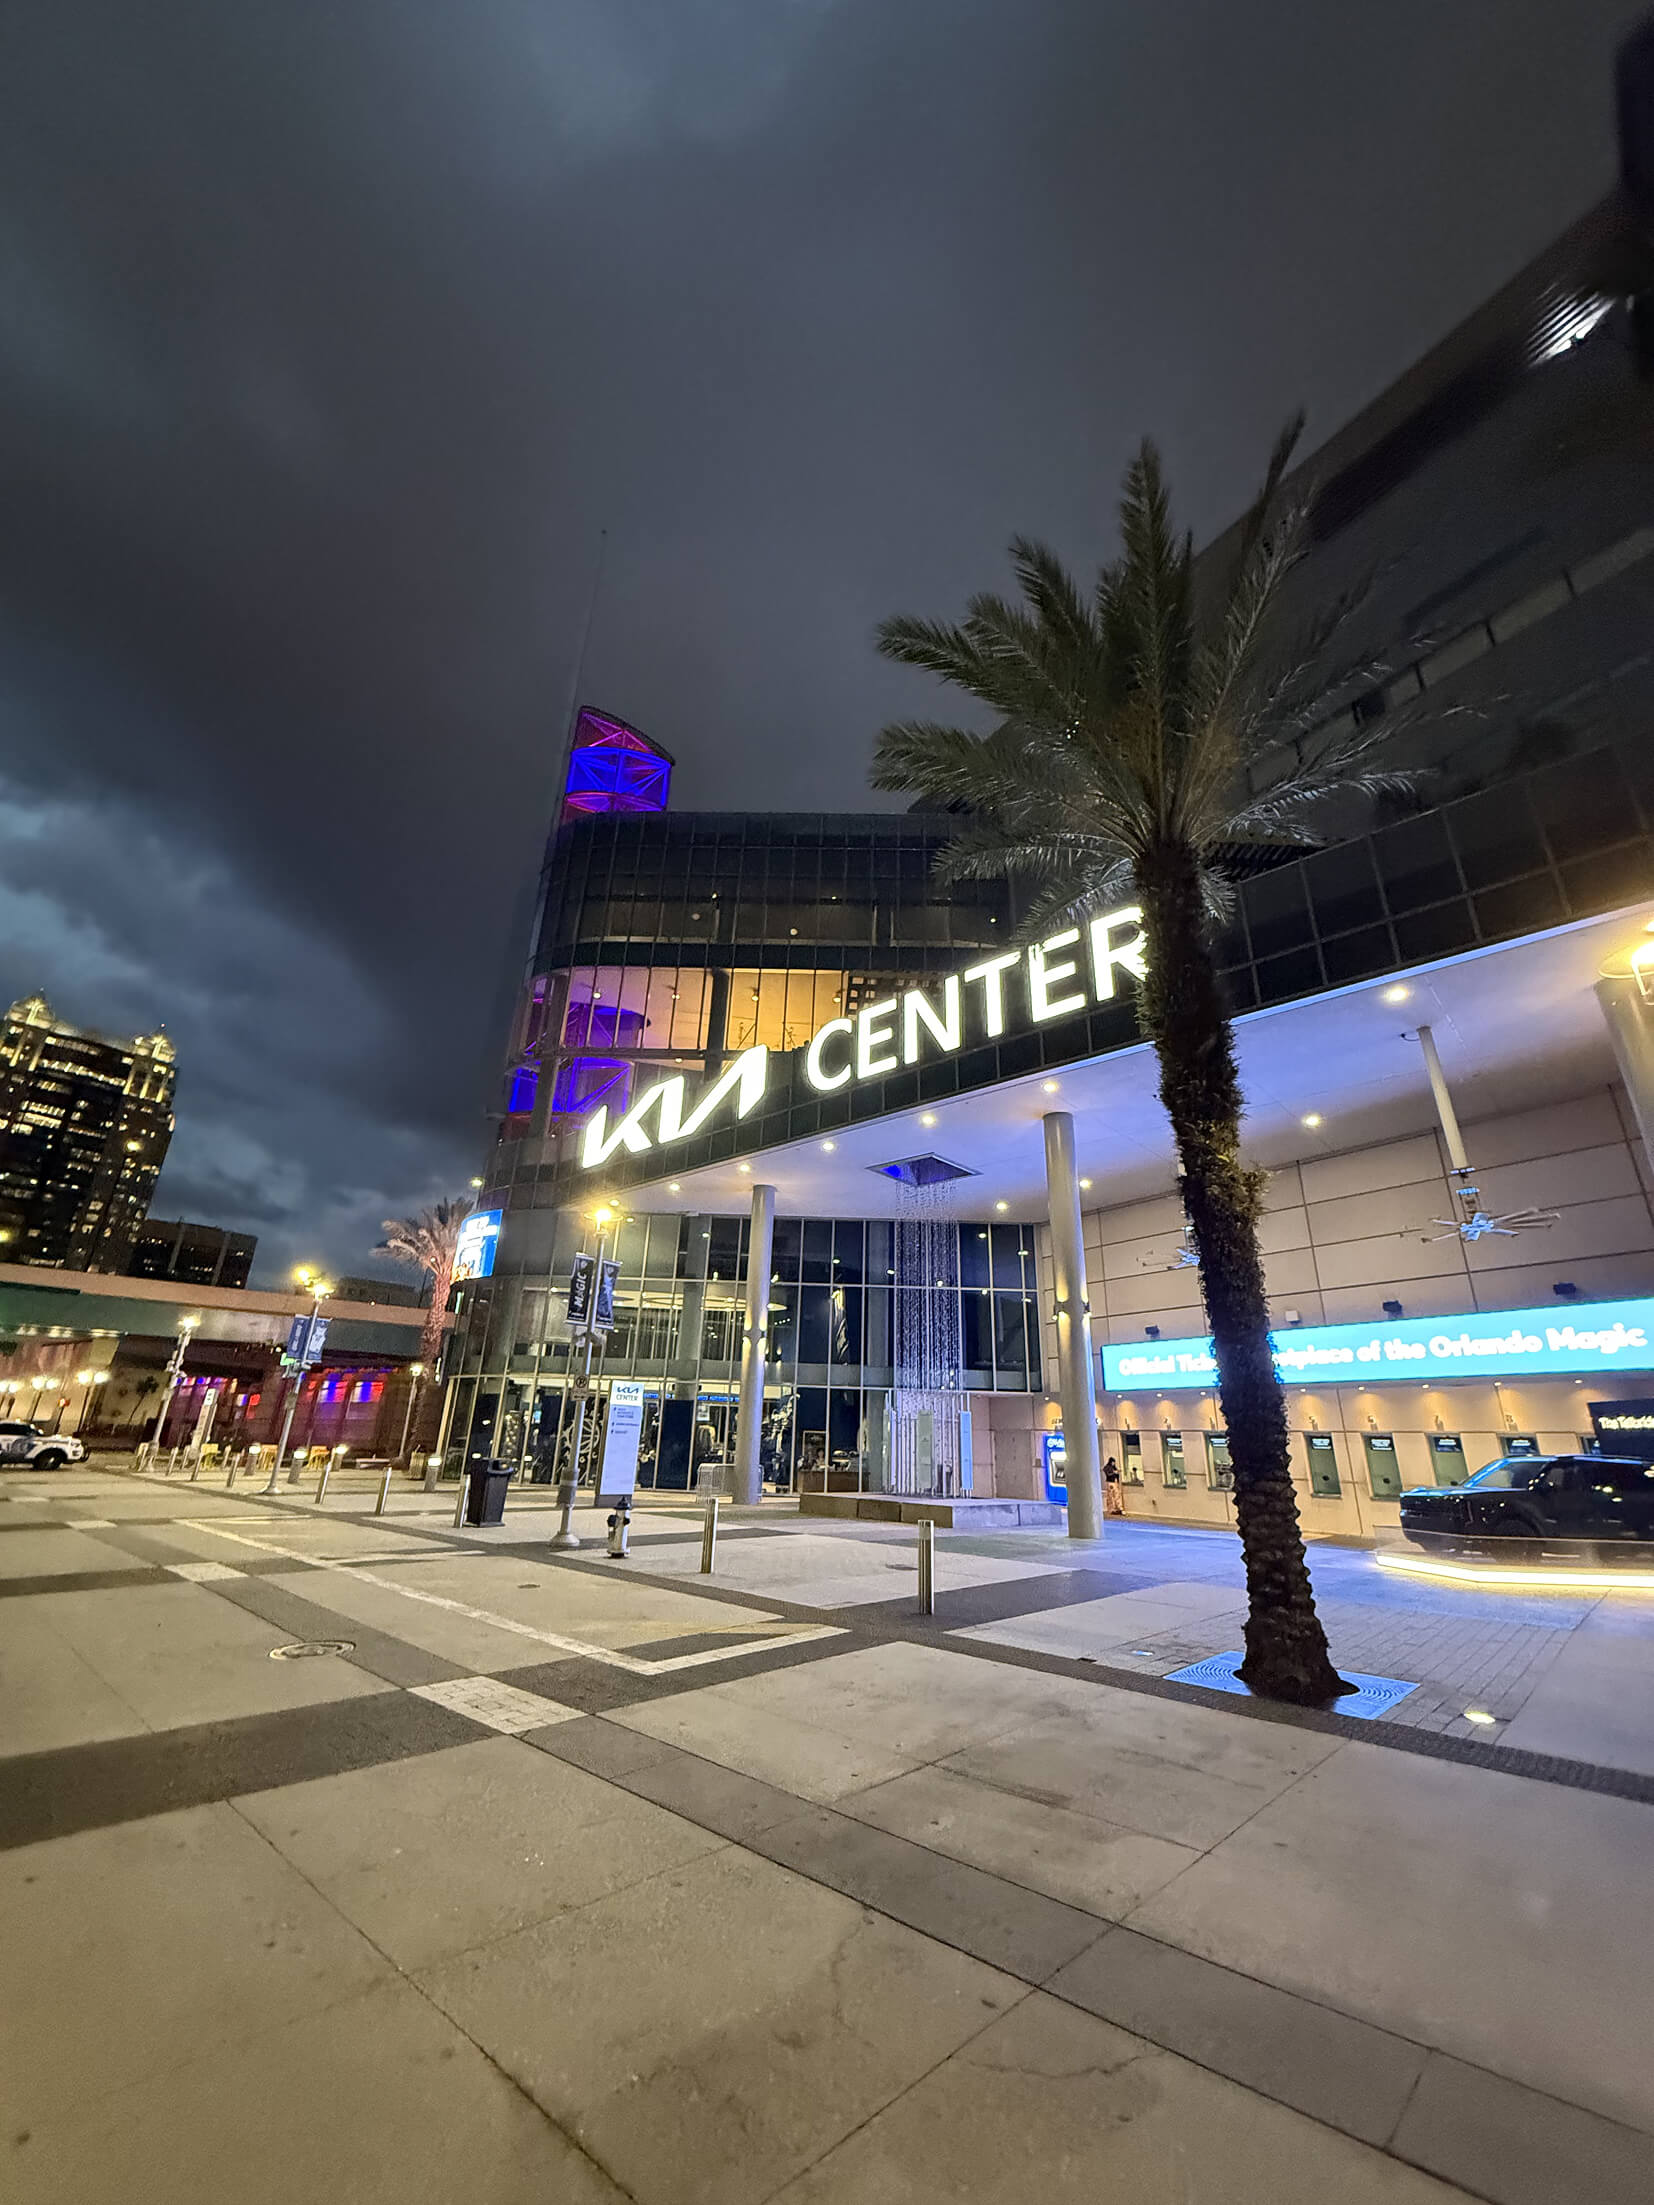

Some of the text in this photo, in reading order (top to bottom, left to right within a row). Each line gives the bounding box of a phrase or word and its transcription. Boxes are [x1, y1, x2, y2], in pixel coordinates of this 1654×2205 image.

[805, 905, 1149, 1093] CENTER
[573, 1271, 588, 1308] MAGIC
[1119, 1354, 1175, 1376] Official
[1176, 1352, 1218, 1372] Ticke
[1356, 1339, 1381, 1362] of
[1384, 1337, 1427, 1360] the
[1429, 1329, 1543, 1358] Orlando
[1545, 1322, 1648, 1354] Magic
